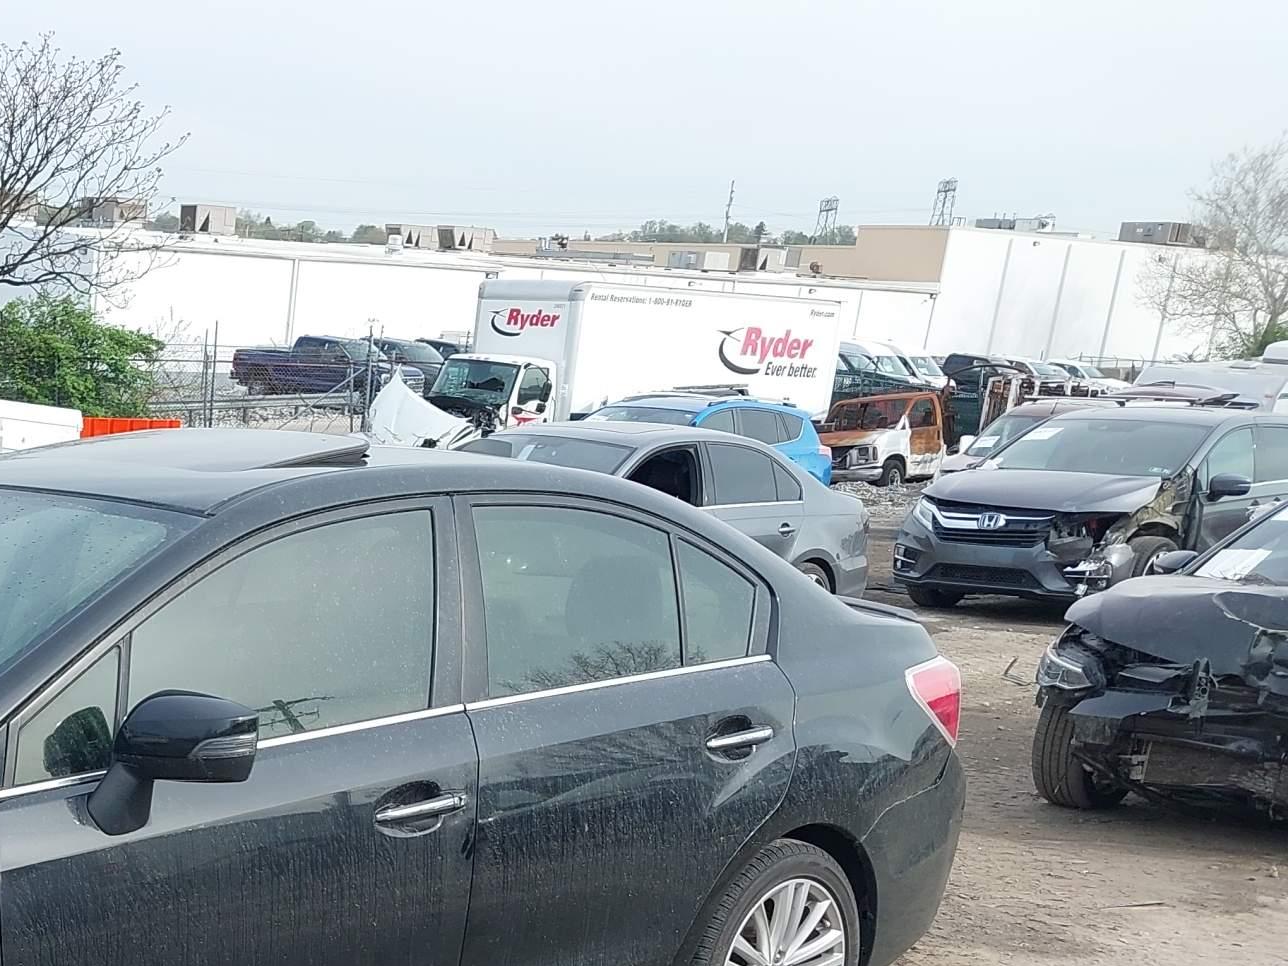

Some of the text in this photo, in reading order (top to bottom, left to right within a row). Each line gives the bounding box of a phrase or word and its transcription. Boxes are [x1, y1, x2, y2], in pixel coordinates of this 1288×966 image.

[506, 308, 561, 330] Ryder
[740, 326, 814, 364] Ryder
[764, 361, 818, 378] Ever better.
